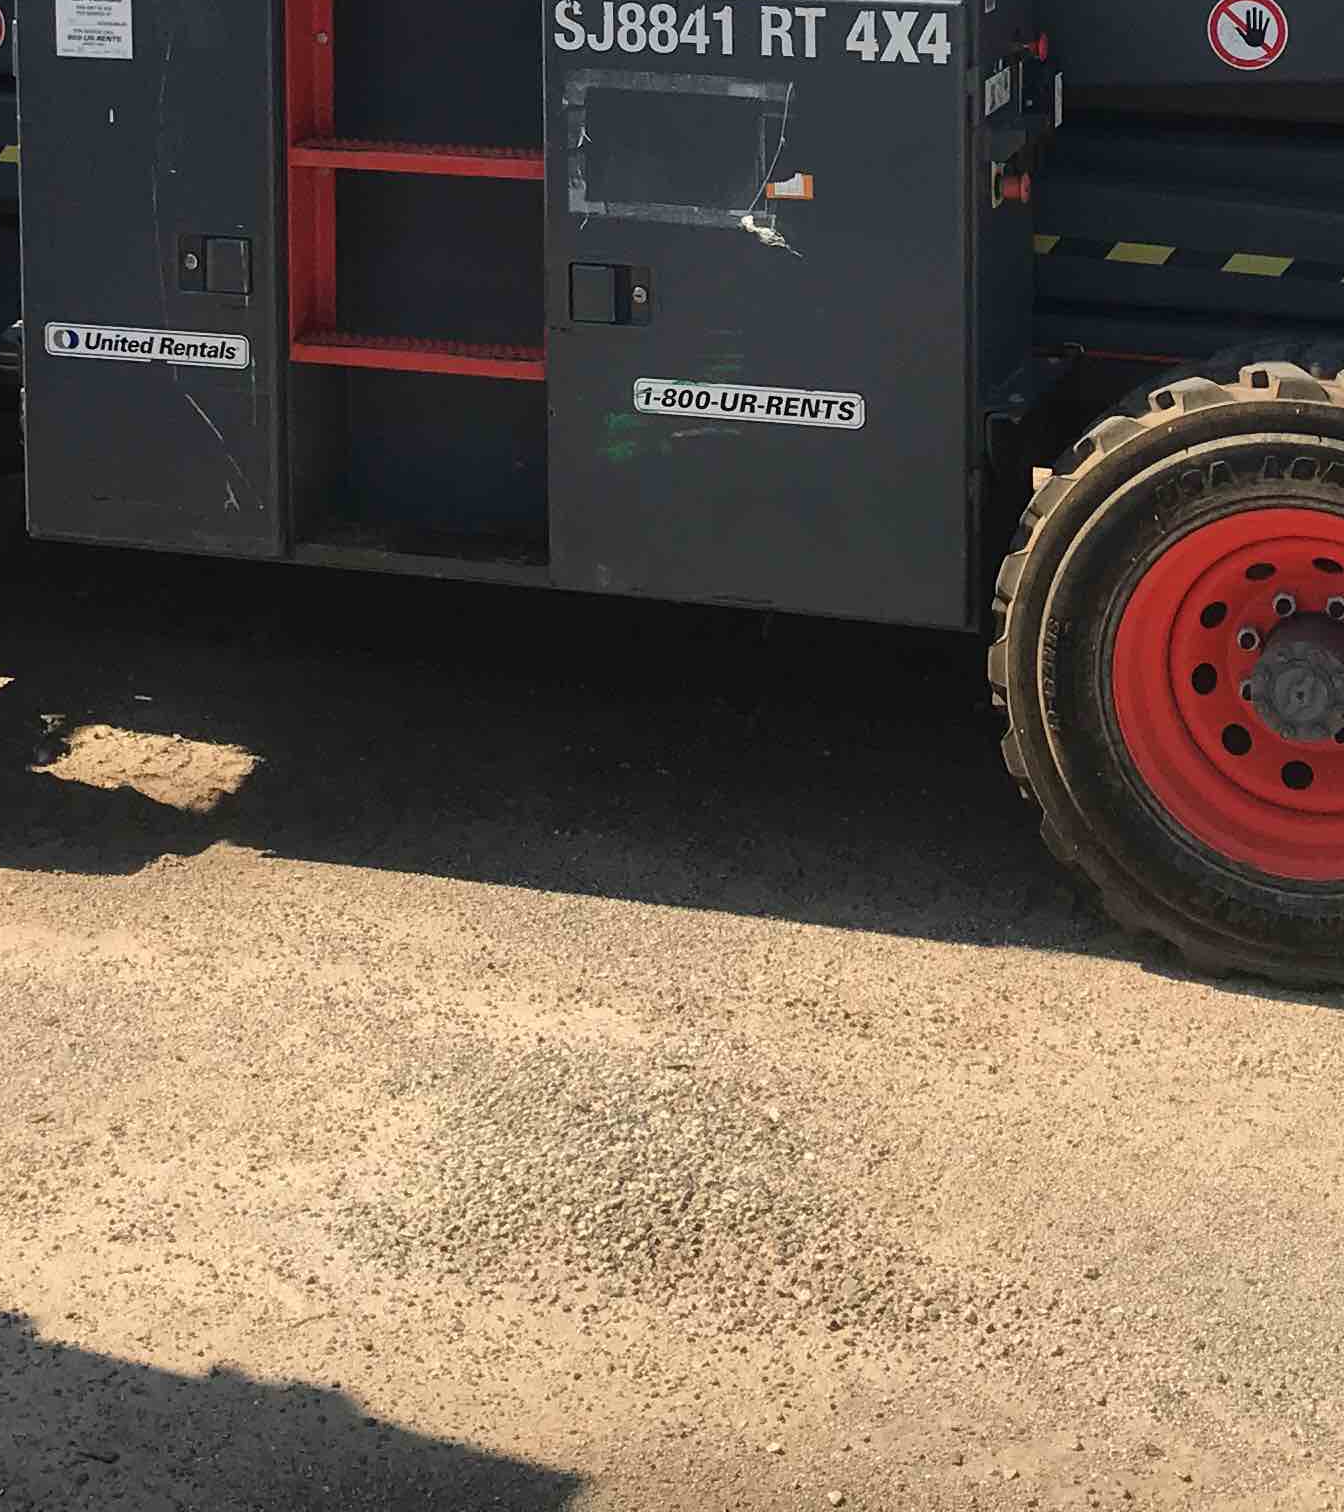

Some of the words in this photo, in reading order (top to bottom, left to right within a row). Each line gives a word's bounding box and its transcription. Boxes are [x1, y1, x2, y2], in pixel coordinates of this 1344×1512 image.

[554, 0, 734, 55] SJ8841
[759, 5, 827, 58] RT
[845, 10, 952, 65] 4X4
[84, 331, 154, 354] United
[159, 337, 237, 360] Rentals
[639, 386, 856, 422] 1-800-UR-RENTS
